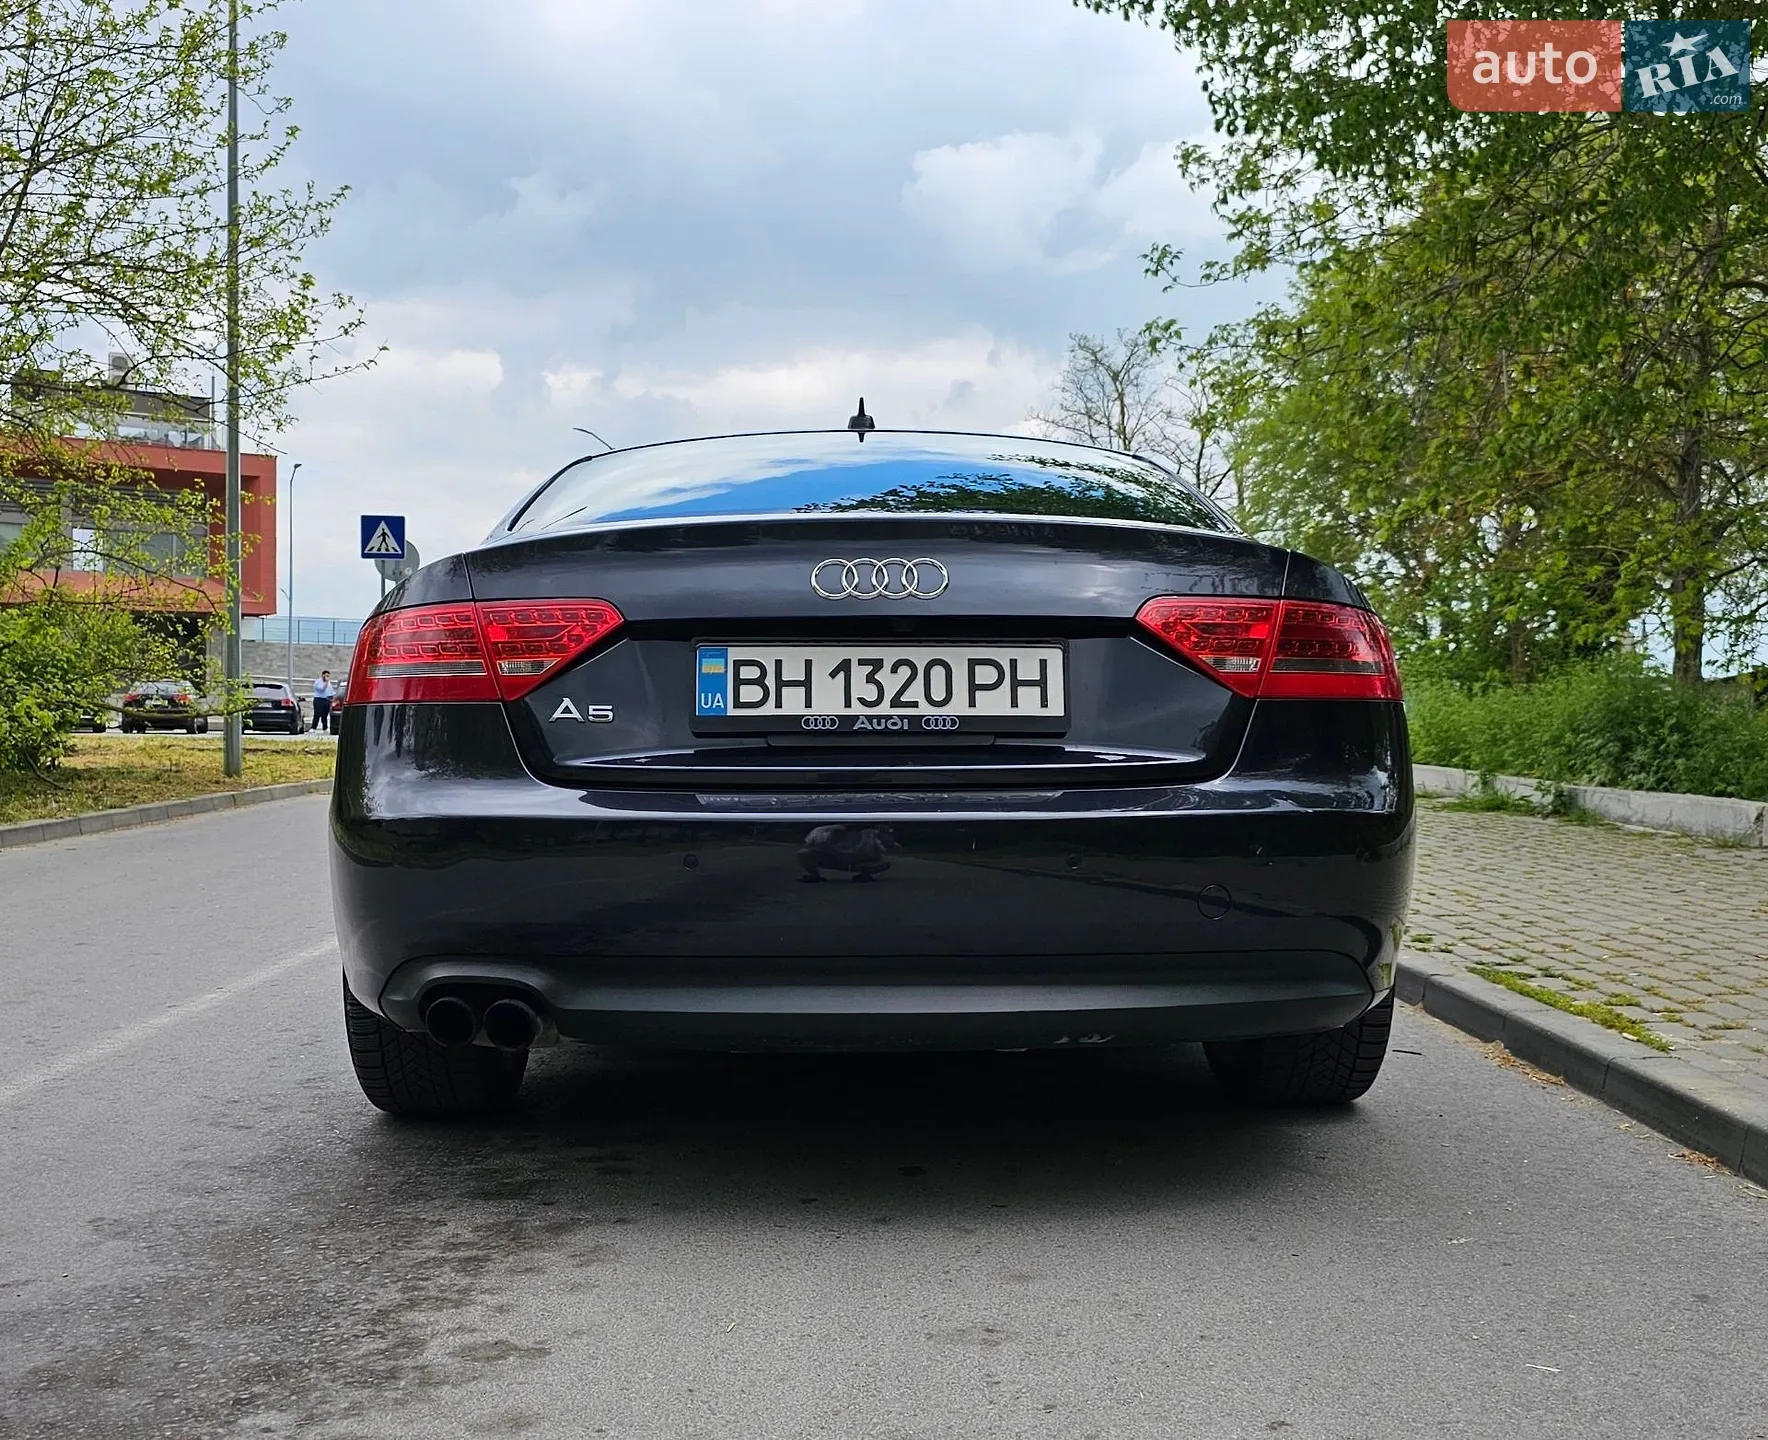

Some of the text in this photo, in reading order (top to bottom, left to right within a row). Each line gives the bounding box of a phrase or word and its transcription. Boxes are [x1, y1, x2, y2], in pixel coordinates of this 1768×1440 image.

[732, 658, 1049, 709] BH 1320 PH
[548, 697, 614, 723] A5
[701, 692, 725, 709] UA
[852, 715, 909, 730] Audi
